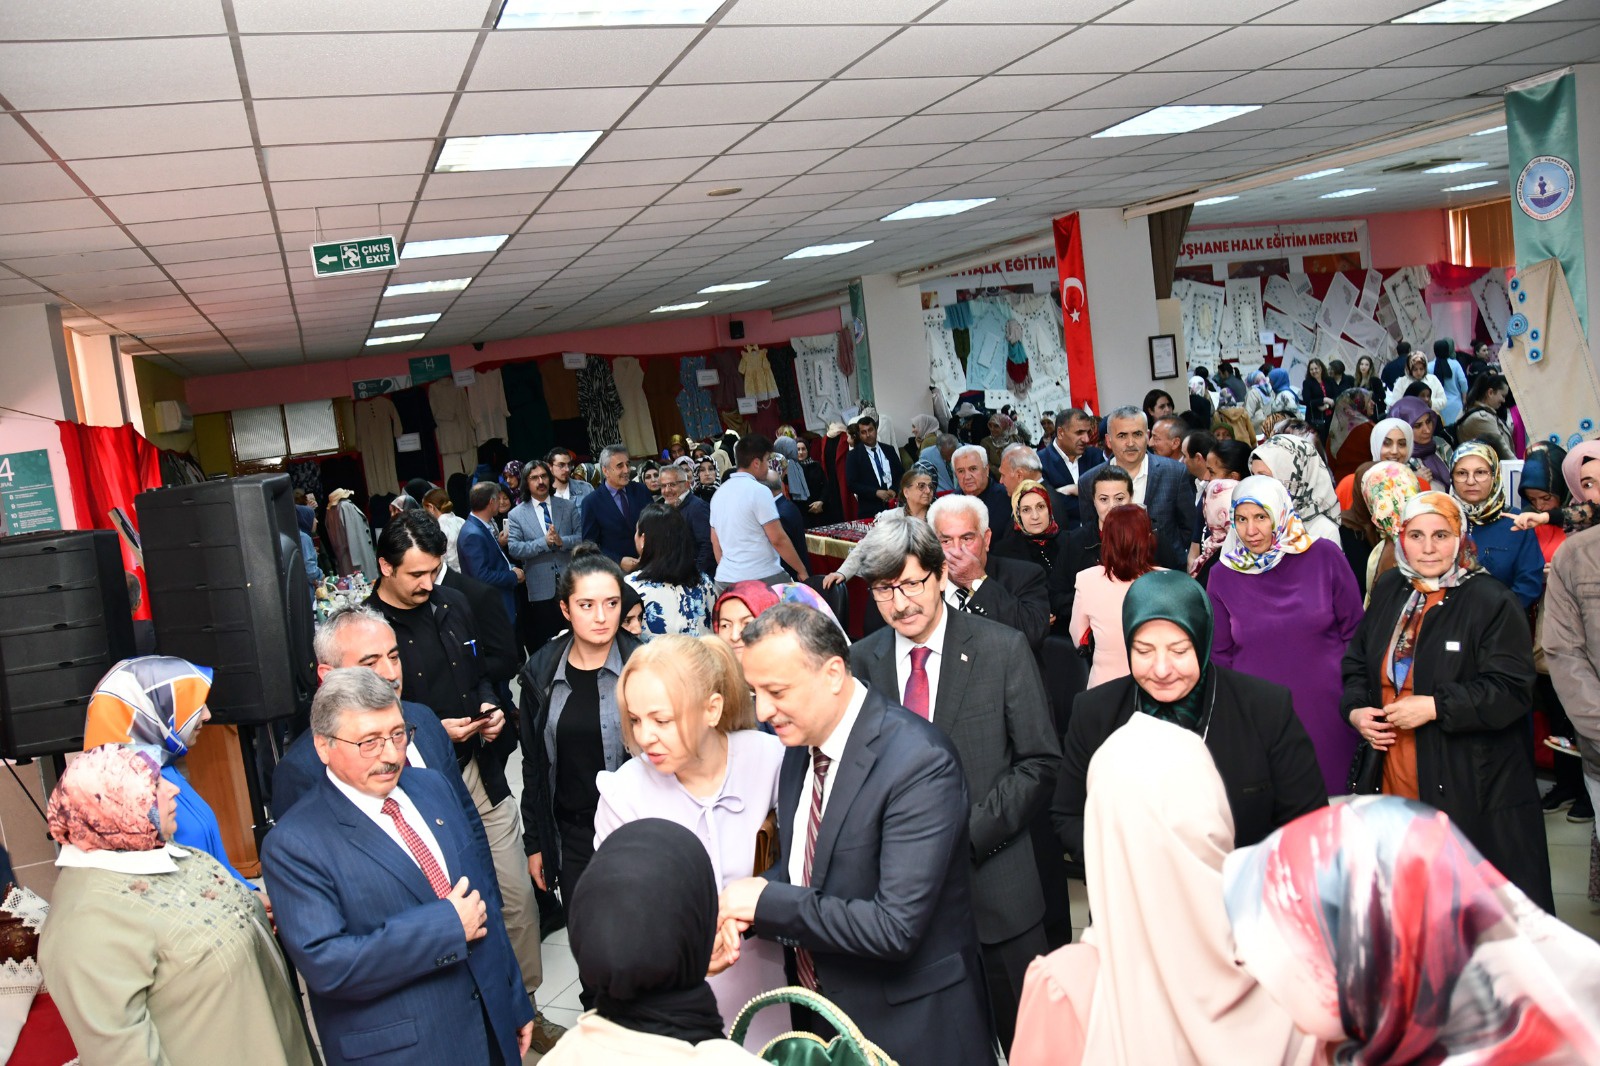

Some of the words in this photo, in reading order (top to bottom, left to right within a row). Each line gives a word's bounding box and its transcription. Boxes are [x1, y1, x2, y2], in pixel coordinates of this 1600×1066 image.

[1231, 237, 1264, 252] HALK
[1266, 232, 1307, 249] EĞİTİM
[1308, 229, 1358, 246] MERKEZİ
[361, 243, 390, 255] ÇIKIŞ
[366, 253, 390, 264] EXIT
[1005, 254, 1056, 272] EĞİTİM
[423, 358, 435, 369] 14
